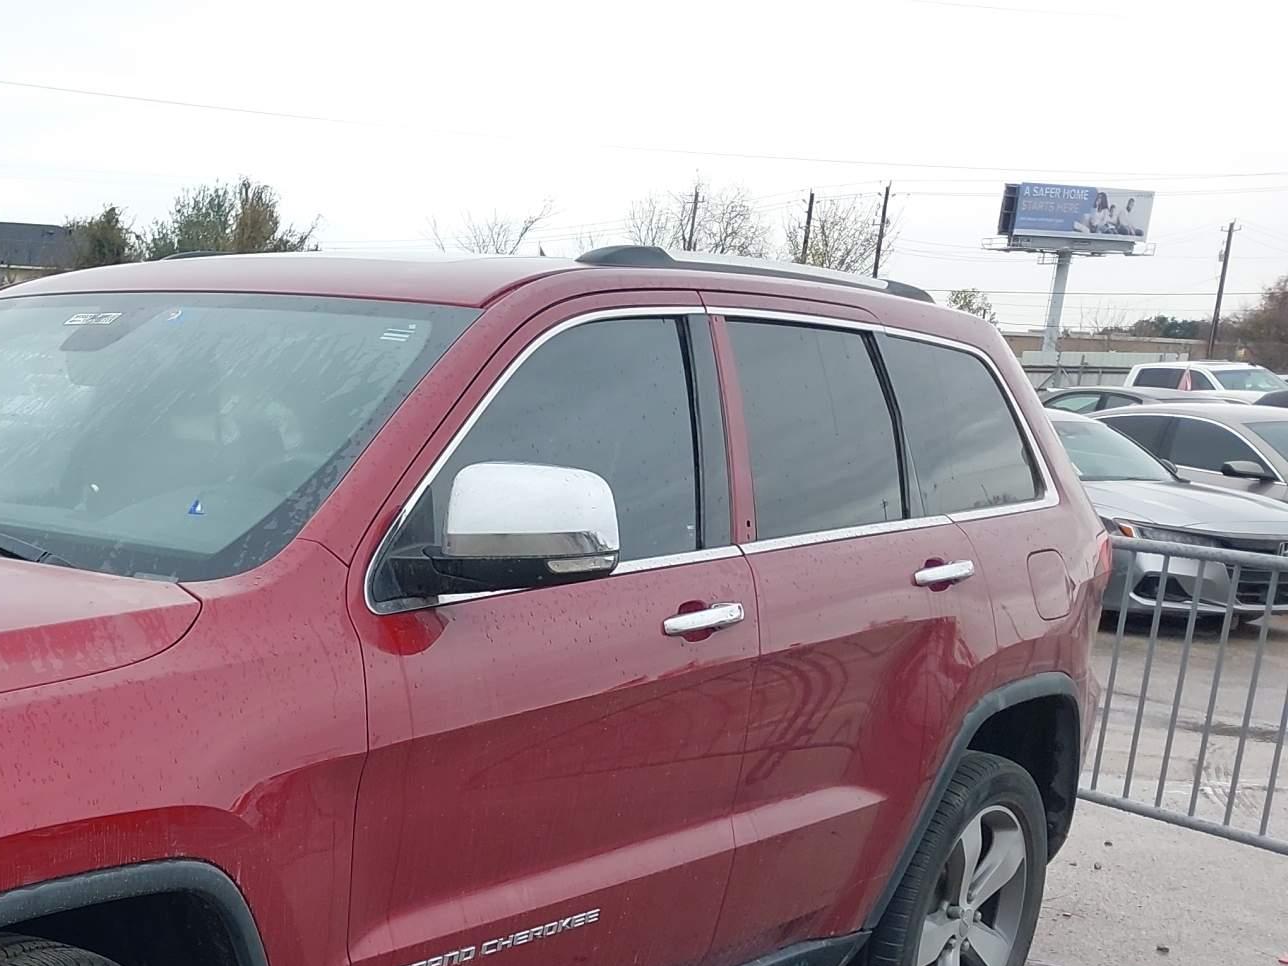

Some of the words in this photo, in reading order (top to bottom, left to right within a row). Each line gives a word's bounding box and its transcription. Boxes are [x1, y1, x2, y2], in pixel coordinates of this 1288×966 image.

[1023, 186, 1031, 197] A
[1032, 186, 1061, 199] SAFER
[1062, 188, 1089, 201] HOME
[480, 908, 601, 955] CHEROKEE
